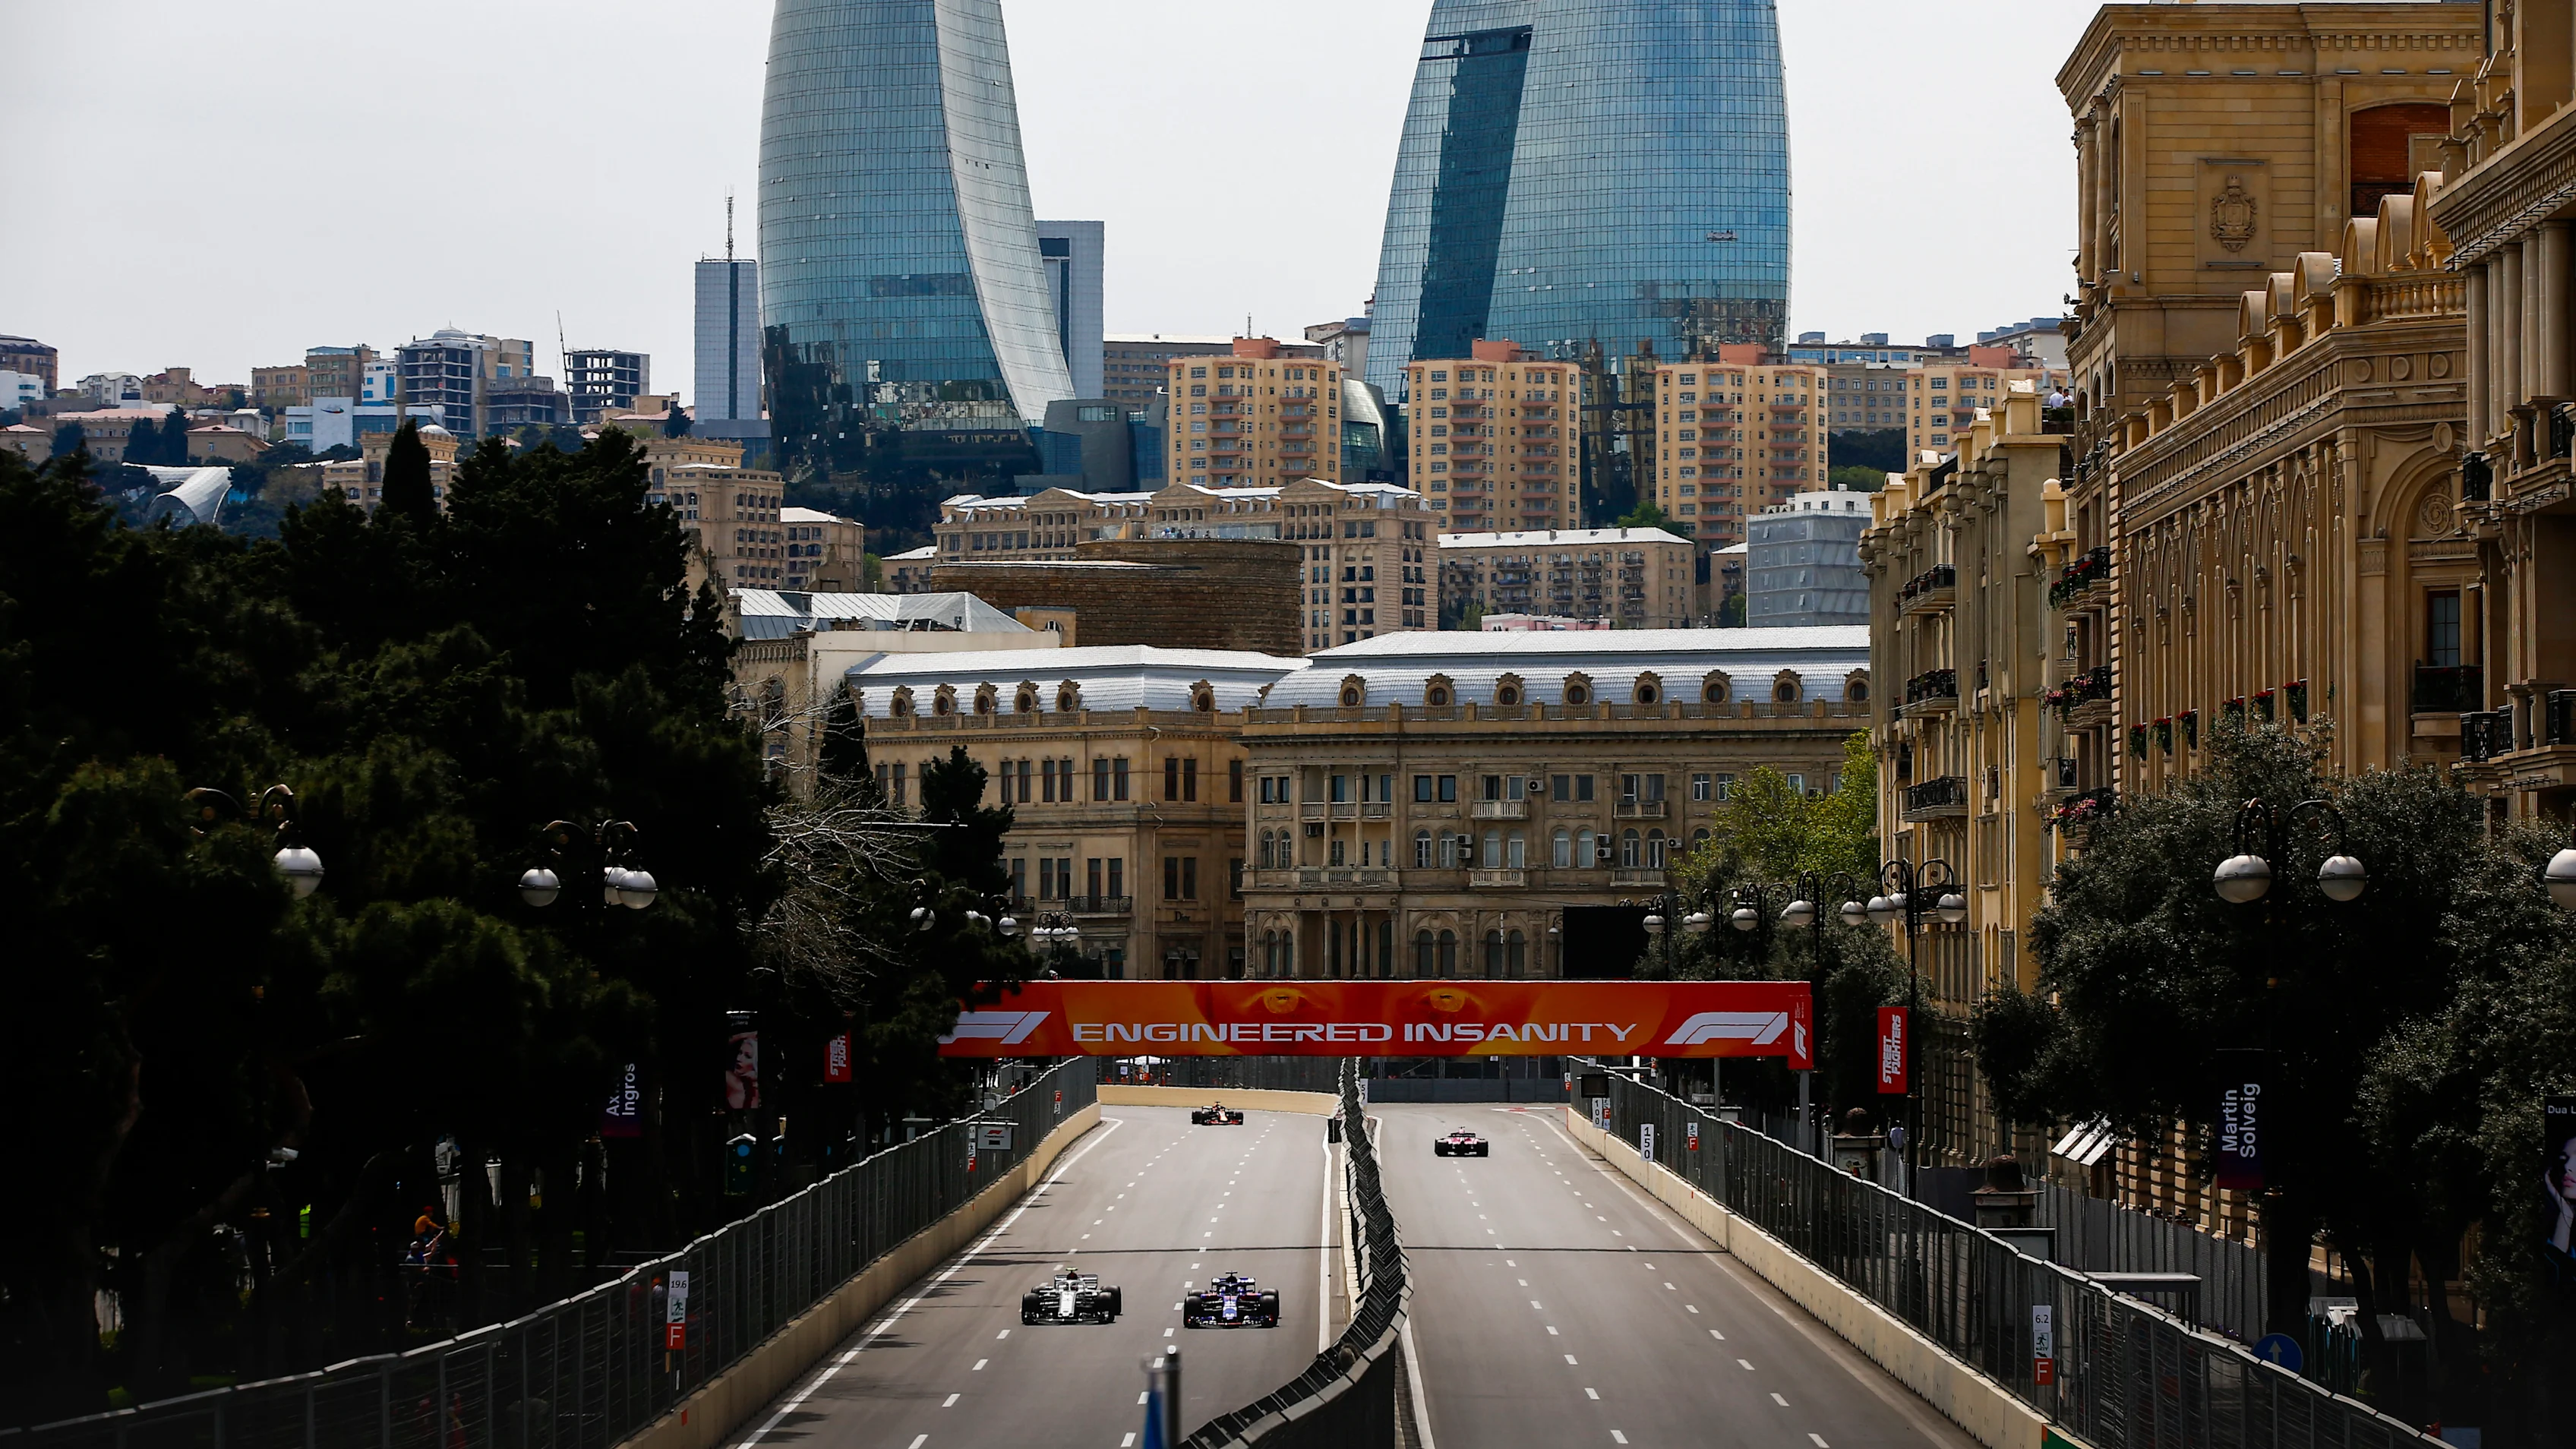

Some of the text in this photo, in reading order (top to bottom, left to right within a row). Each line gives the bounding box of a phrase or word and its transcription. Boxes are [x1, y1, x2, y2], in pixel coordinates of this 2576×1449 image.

[1073, 1023, 1637, 1042] ENGINEERED INSANITY
[1891, 1014, 1902, 1075] FIGHTERS
[829, 1039, 839, 1076] STREE
[1883, 1035, 1893, 1084] STREET
[621, 1062, 640, 1116] Ingros
[1055, 1092, 1061, 1101] F
[2547, 1104, 2568, 1114] Dua
[2221, 1089, 2238, 1151] Martin
[2239, 1083, 2261, 1158] Solveig
[1689, 1138, 1697, 1149] F
[671, 1280, 687, 1289] 19.6
[2035, 1314, 2049, 1324] 6.2
[670, 1325, 683, 1346] F
[2037, 1361, 2049, 1381] F
